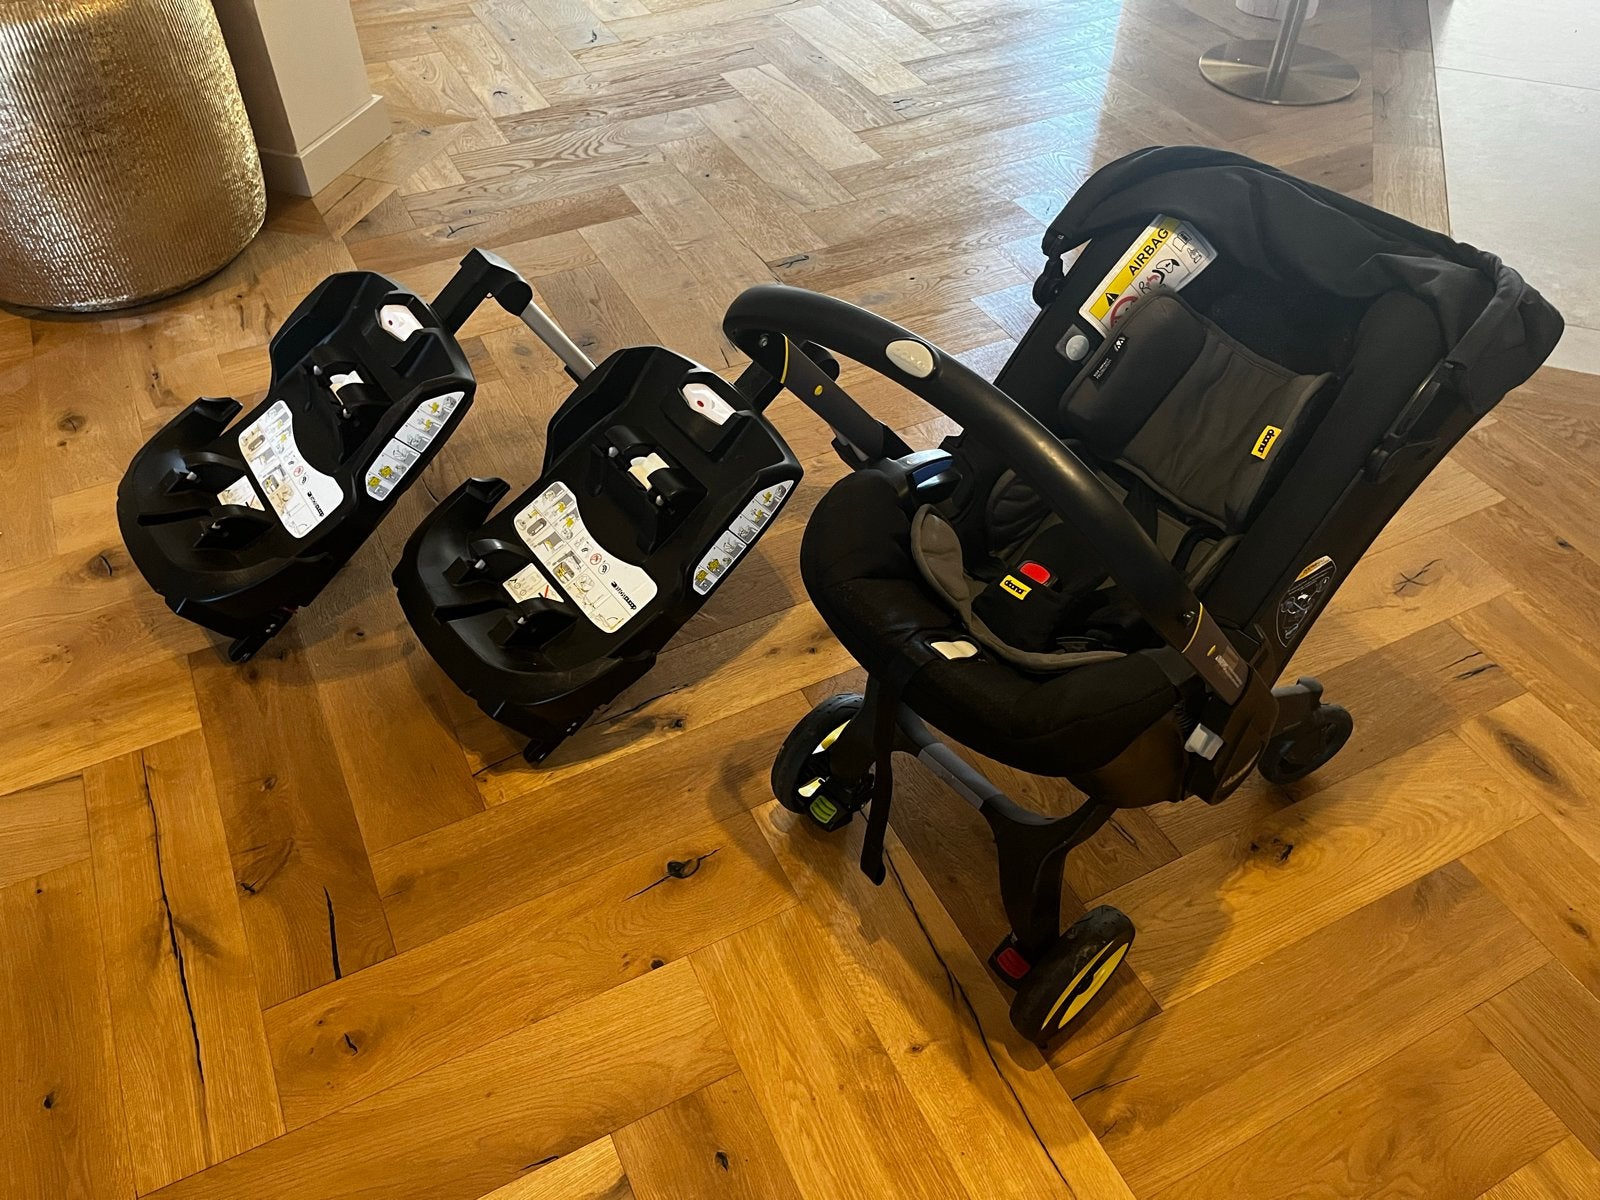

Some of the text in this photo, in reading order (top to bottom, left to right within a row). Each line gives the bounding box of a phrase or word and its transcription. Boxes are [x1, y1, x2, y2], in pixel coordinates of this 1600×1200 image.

[1128, 228, 1169, 276] AIRBAG
[1257, 429, 1275, 454] doona
[1004, 579, 1025, 595] doona
